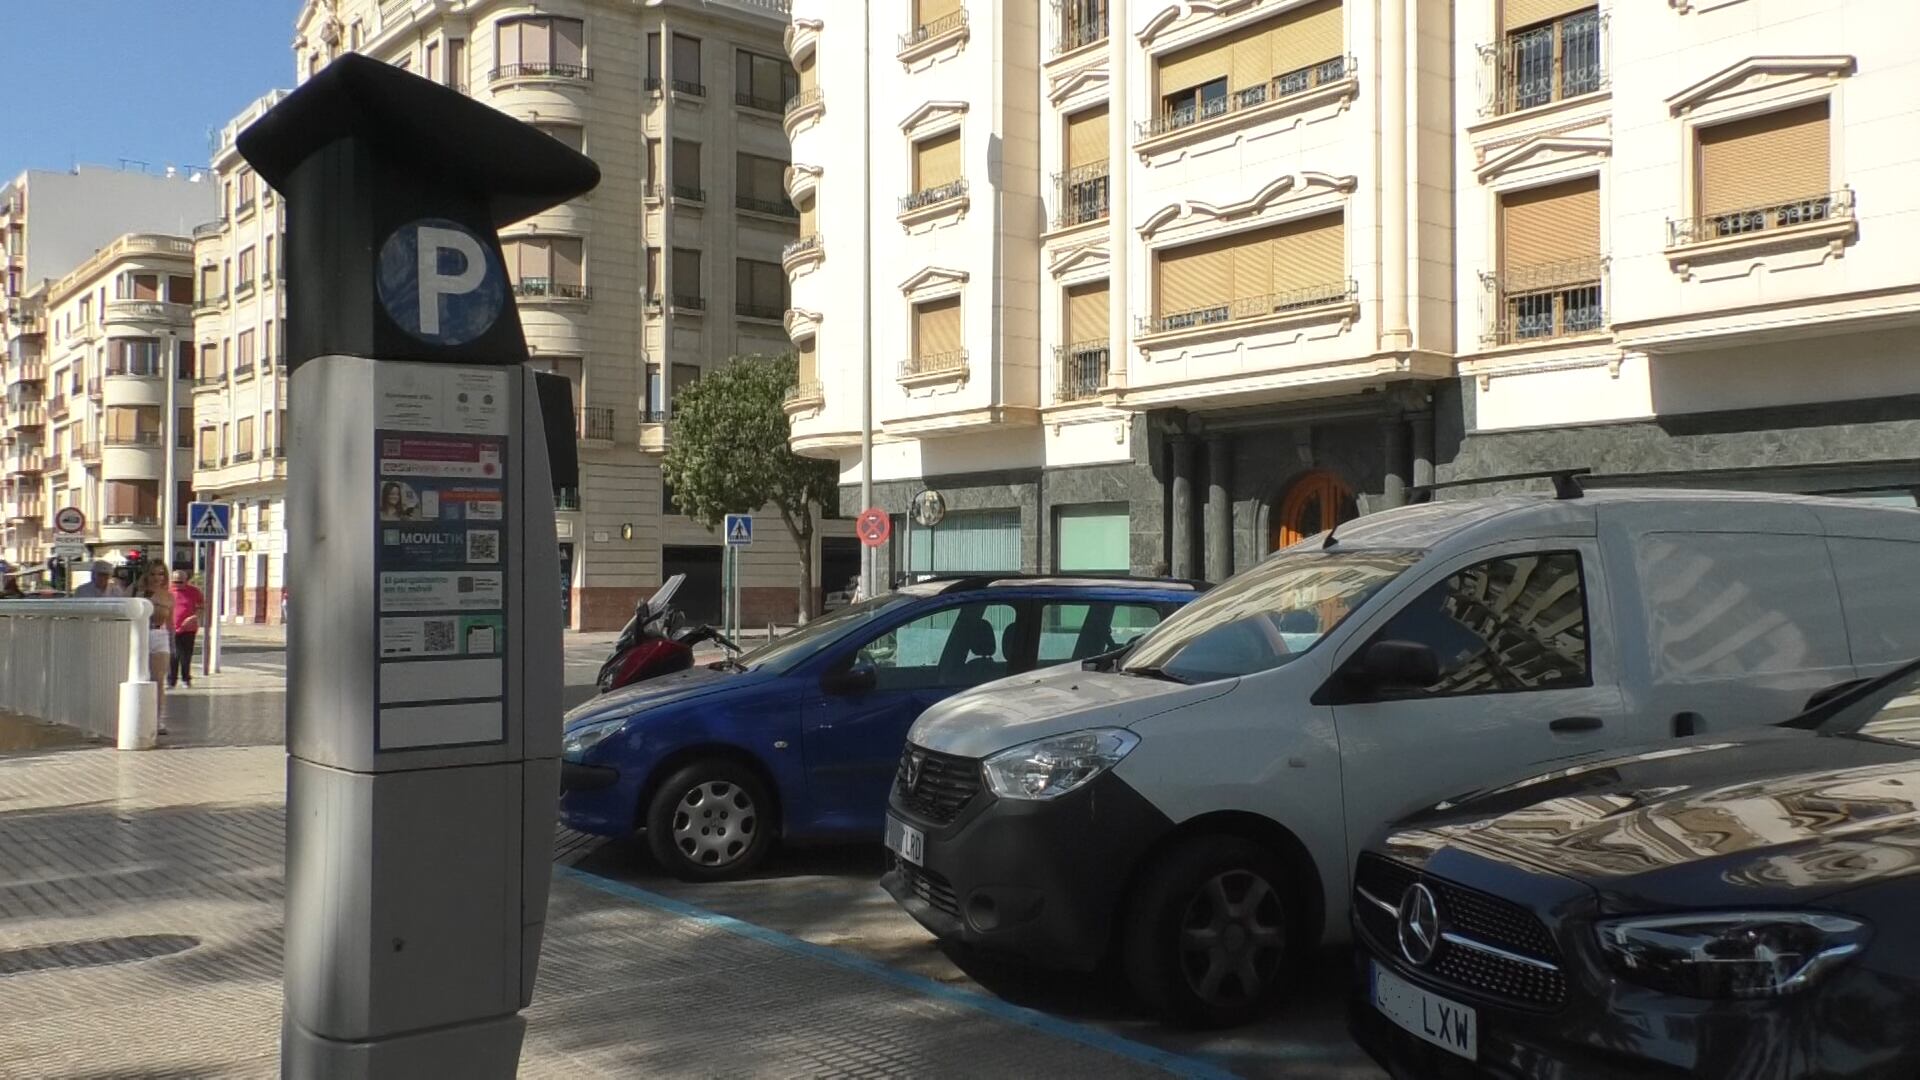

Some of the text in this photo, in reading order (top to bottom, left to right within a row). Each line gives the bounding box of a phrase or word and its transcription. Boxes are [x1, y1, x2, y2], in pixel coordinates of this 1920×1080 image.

[417, 226, 486, 335] P
[400, 532, 464, 545] MOVILTIK
[1422, 996, 1468, 1051] LXW
